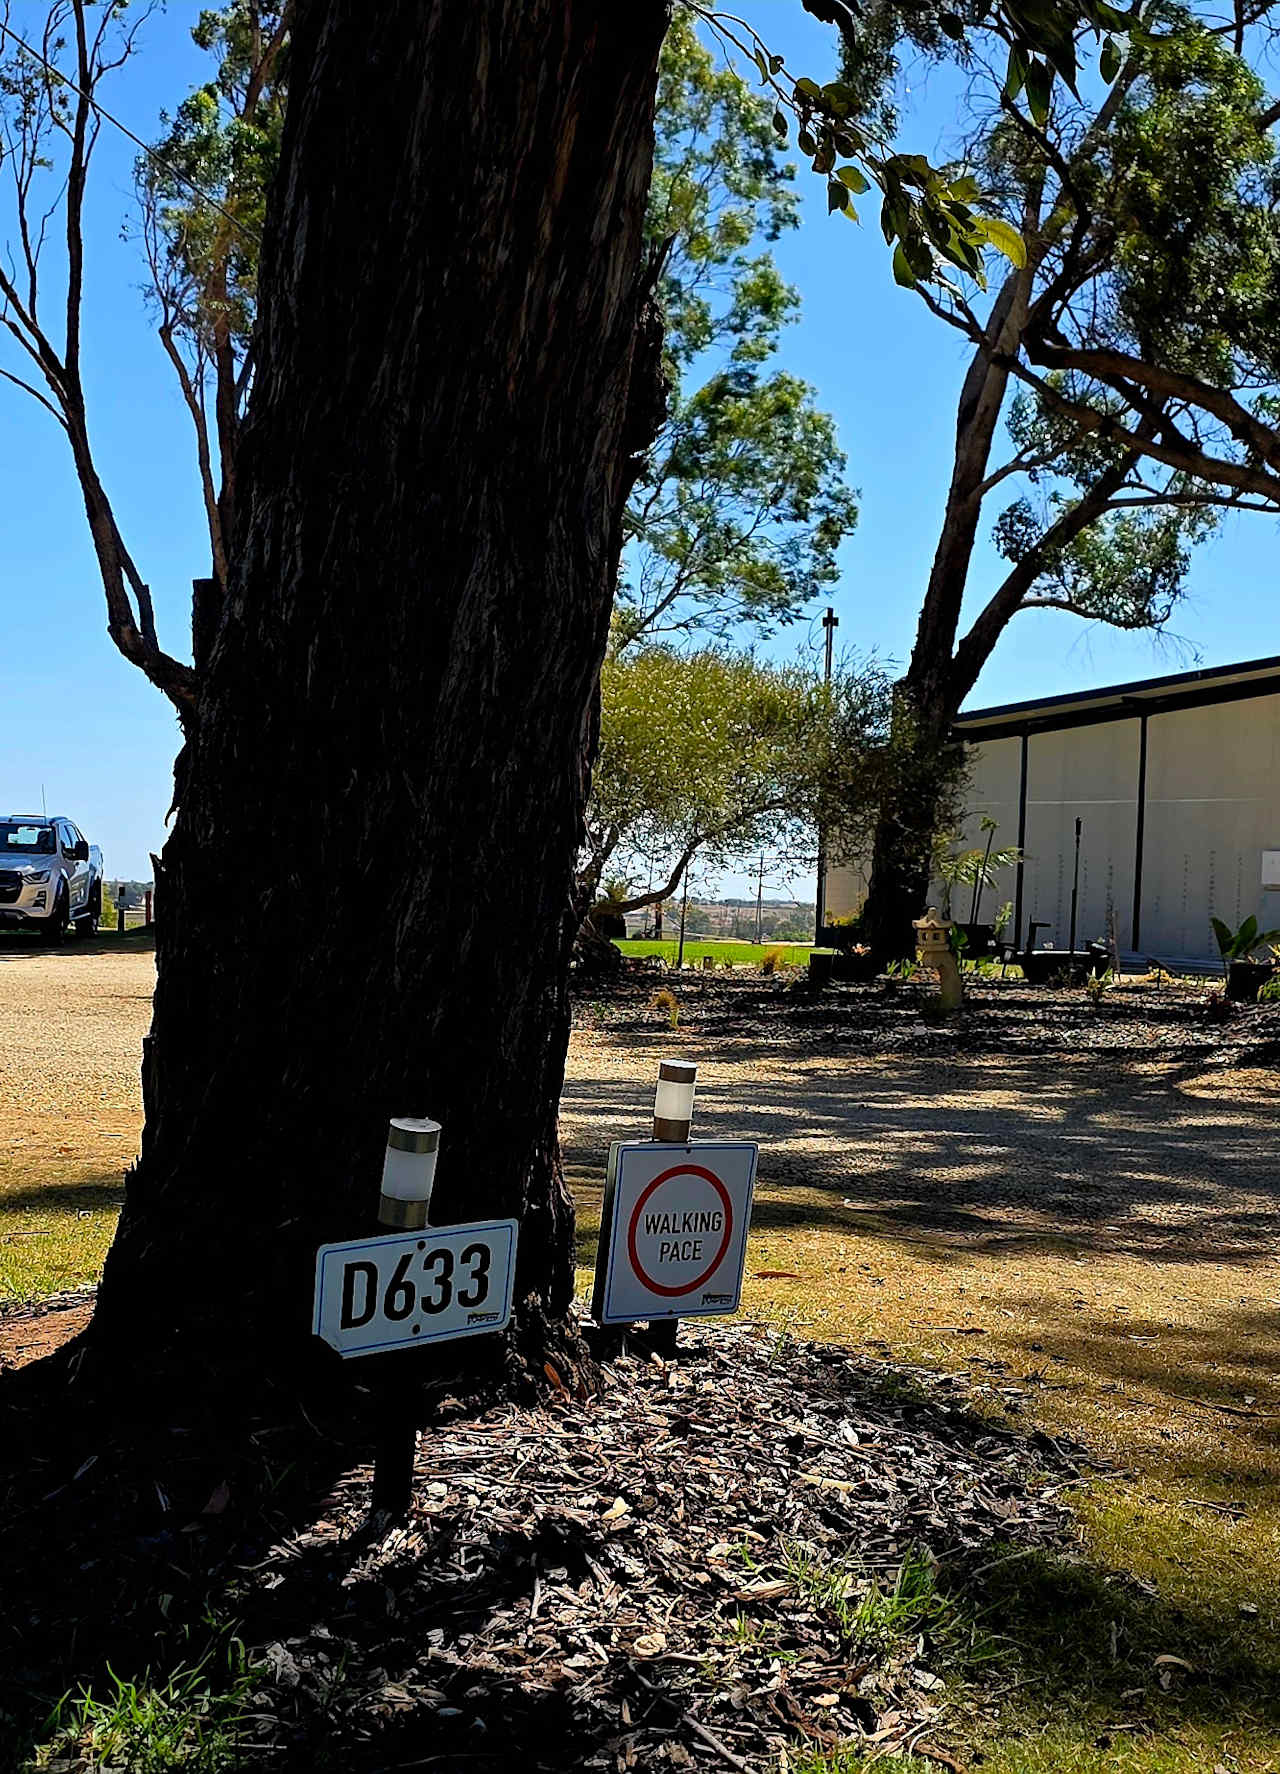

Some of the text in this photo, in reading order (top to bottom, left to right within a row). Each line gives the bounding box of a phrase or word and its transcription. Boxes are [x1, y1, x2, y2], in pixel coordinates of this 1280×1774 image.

[645, 1211, 723, 1235] WALKING
[659, 1240, 703, 1263] PACE
[340, 1242, 491, 1330] D633
